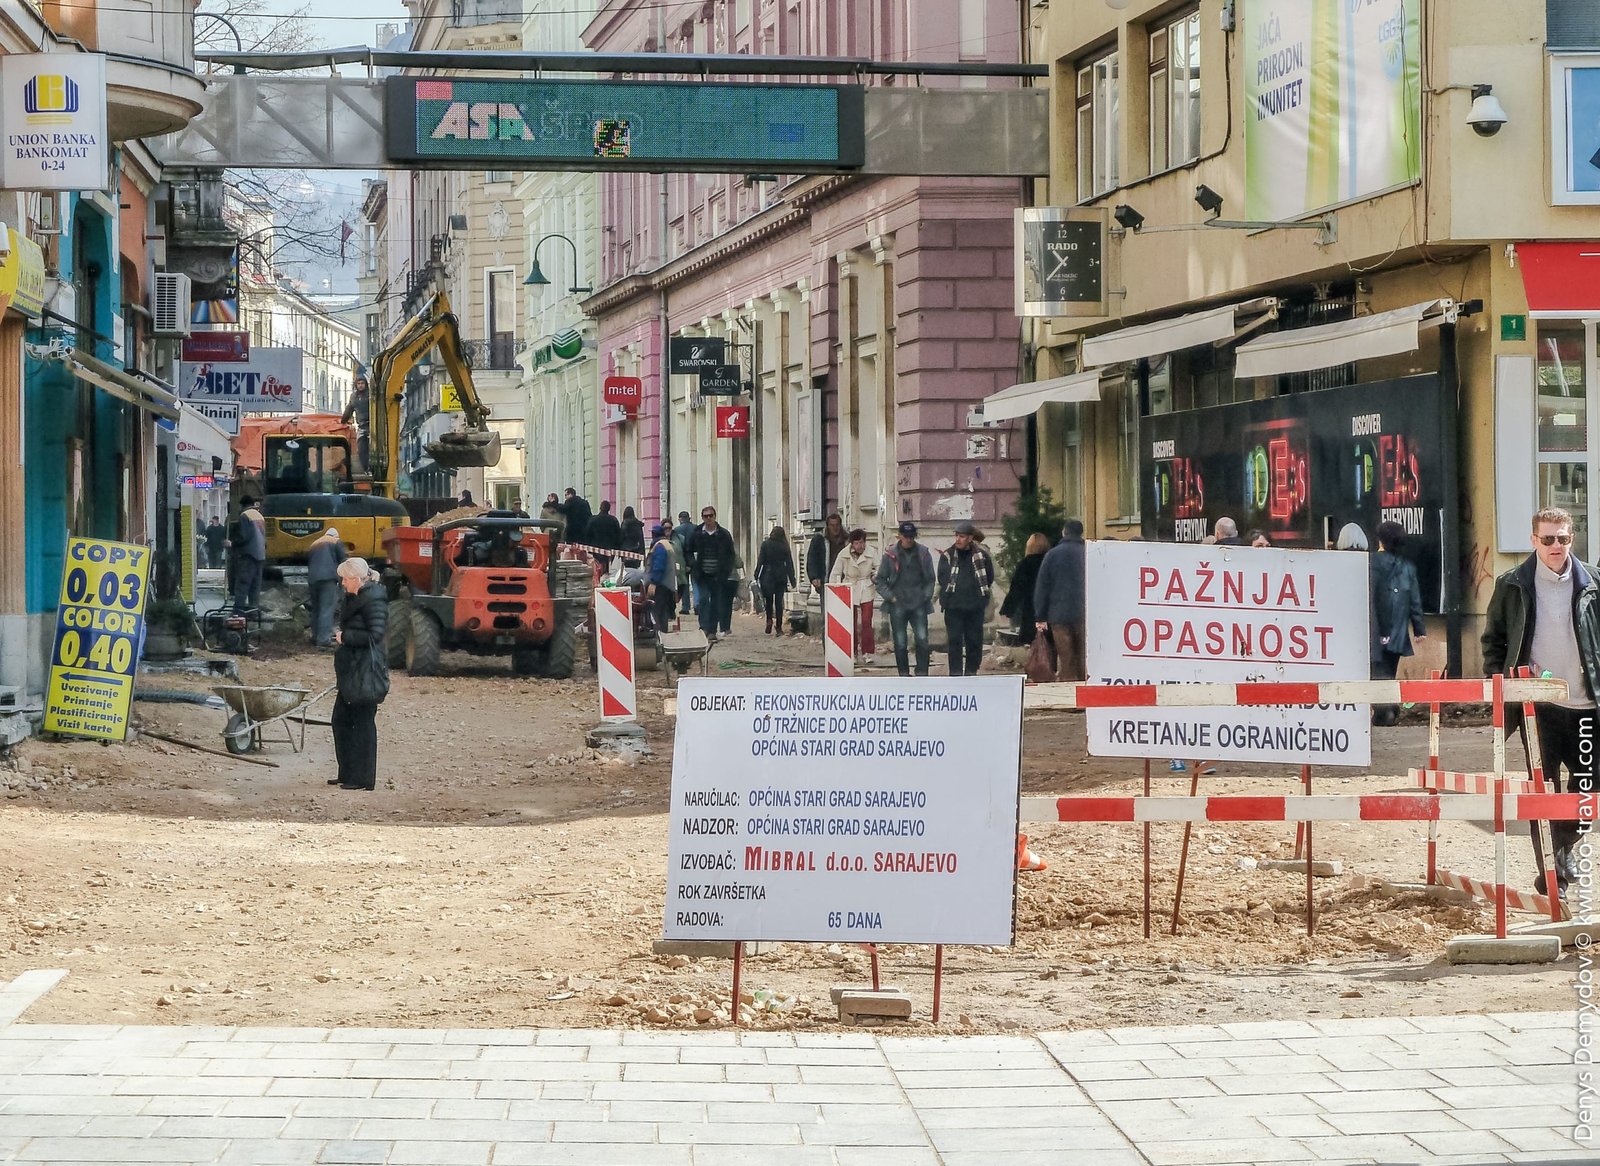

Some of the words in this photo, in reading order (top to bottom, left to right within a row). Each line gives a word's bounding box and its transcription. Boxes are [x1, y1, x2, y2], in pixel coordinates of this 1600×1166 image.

[1257, 12, 1281, 49] JAČA
[1257, 42, 1303, 86] PRIRODNI
[1257, 79, 1303, 121] IMUNITET
[431, 102, 535, 140] ASA
[9, 133, 49, 146] UNION
[53, 133, 96, 145] BANKA
[16, 147, 88, 159] BANKOMAT
[41, 160, 65, 171] 0-24
[1047, 242, 1078, 251] RADO
[679, 358, 717, 367] SWAROVSKI
[260, 374, 292, 397] Live
[608, 384, 637, 396] m:tel
[702, 379, 738, 388] GARDEN
[1351, 413, 1381, 436] DISCOVER
[1152, 439, 1175, 459] DISCOVER
[1175, 518, 1208, 542] EVERYDAY
[71, 542, 144, 567] COPY
[67, 567, 141, 609] 0,03
[1139, 561, 1316, 607] PAŽNJA!
[63, 607, 136, 635] COLOR
[1123, 618, 1334, 660] OPASNOST
[60, 630, 132, 673] 0,40
[61, 683, 119, 698] Uvezivanje
[63, 695, 113, 710] Printanje
[690, 695, 746, 711] OBJEKAT:
[754, 694, 865, 711] REKONSTRUKCIJA
[869, 694, 905, 711] ULICE
[908, 695, 978, 712] FERHADIJA
[50, 706, 123, 723] Plastificiranje
[57, 718, 81, 728] Vizit
[84, 722, 112, 733] karte
[753, 716, 771, 734] OD
[774, 713, 825, 733] TRŽNICE
[829, 717, 847, 733] DO
[849, 717, 908, 734] APOTEKE
[752, 735, 798, 756] OPĆINA
[800, 739, 836, 756] STARI
[839, 739, 875, 756] GRAD
[878, 740, 945, 757] SARAJEVO
[1108, 719, 1211, 747] KRETANJE
[1217, 721, 1349, 753] OGRANIČENO
[684, 787, 740, 807] NARUČILAC:
[749, 786, 791, 807] OPĆINA
[794, 790, 826, 807] STARI
[829, 790, 862, 807] GRAD
[865, 791, 926, 808] SARAJEVO
[683, 818, 739, 835] NADZOR:
[747, 814, 790, 835] OPĆINA
[792, 818, 825, 835] STARI
[827, 818, 860, 836] GRAD
[863, 819, 925, 836] SARAJEVO
[681, 850, 736, 870] IZVOĐAČ:
[744, 846, 816, 871] MIBRAL
[826, 851, 868, 871] d.o.o.
[874, 851, 957, 873] SARAJEVO
[678, 884, 701, 899] ROK
[703, 881, 766, 900] ZAVRŠETKA
[676, 911, 724, 927] RADOVA:
[828, 911, 842, 928] 65
[847, 911, 882, 929] DANA
